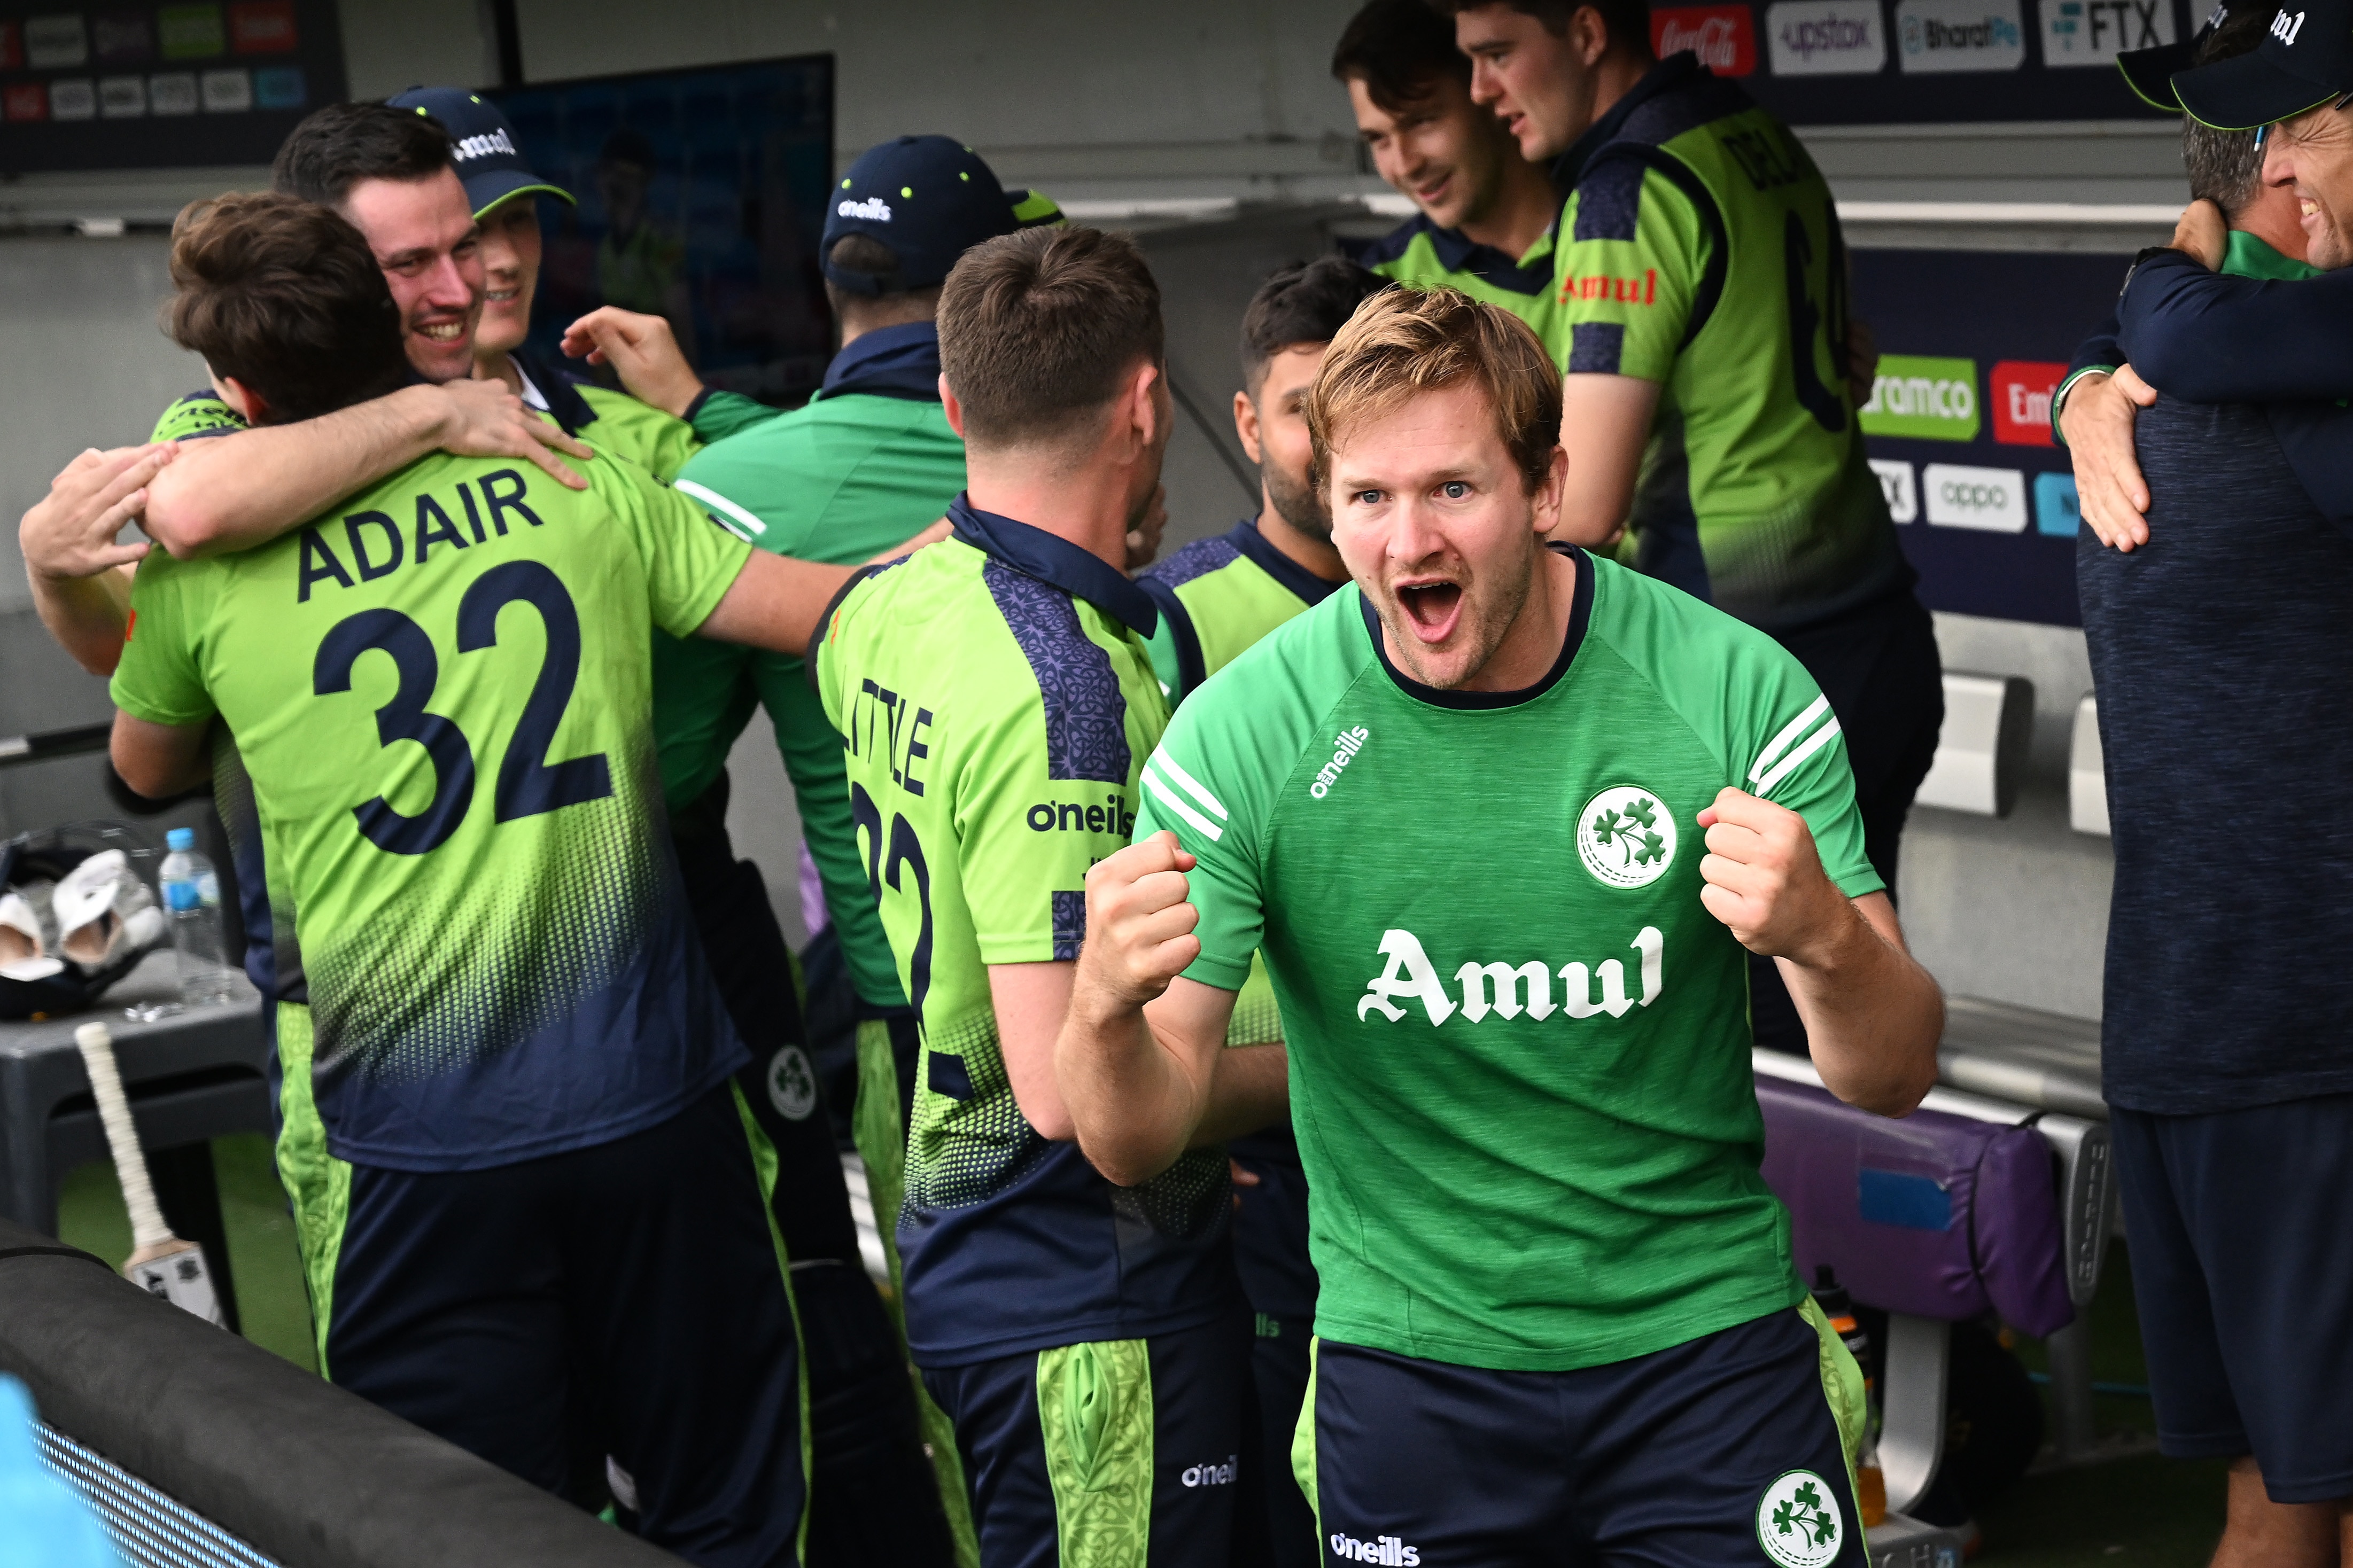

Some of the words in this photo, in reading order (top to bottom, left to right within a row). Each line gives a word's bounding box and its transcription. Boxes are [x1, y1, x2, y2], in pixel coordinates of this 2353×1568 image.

[1781, 13, 1870, 62] upstox
[2088, 0, 2161, 50] FTX
[452, 127, 517, 162] mul
[1559, 269, 1656, 305] Amul
[1861, 375, 1974, 419] ramco
[1940, 481, 2009, 512] oppo
[297, 468, 544, 603] ADAIR
[313, 560, 613, 855] 32
[1357, 926, 1664, 1027] Amul
